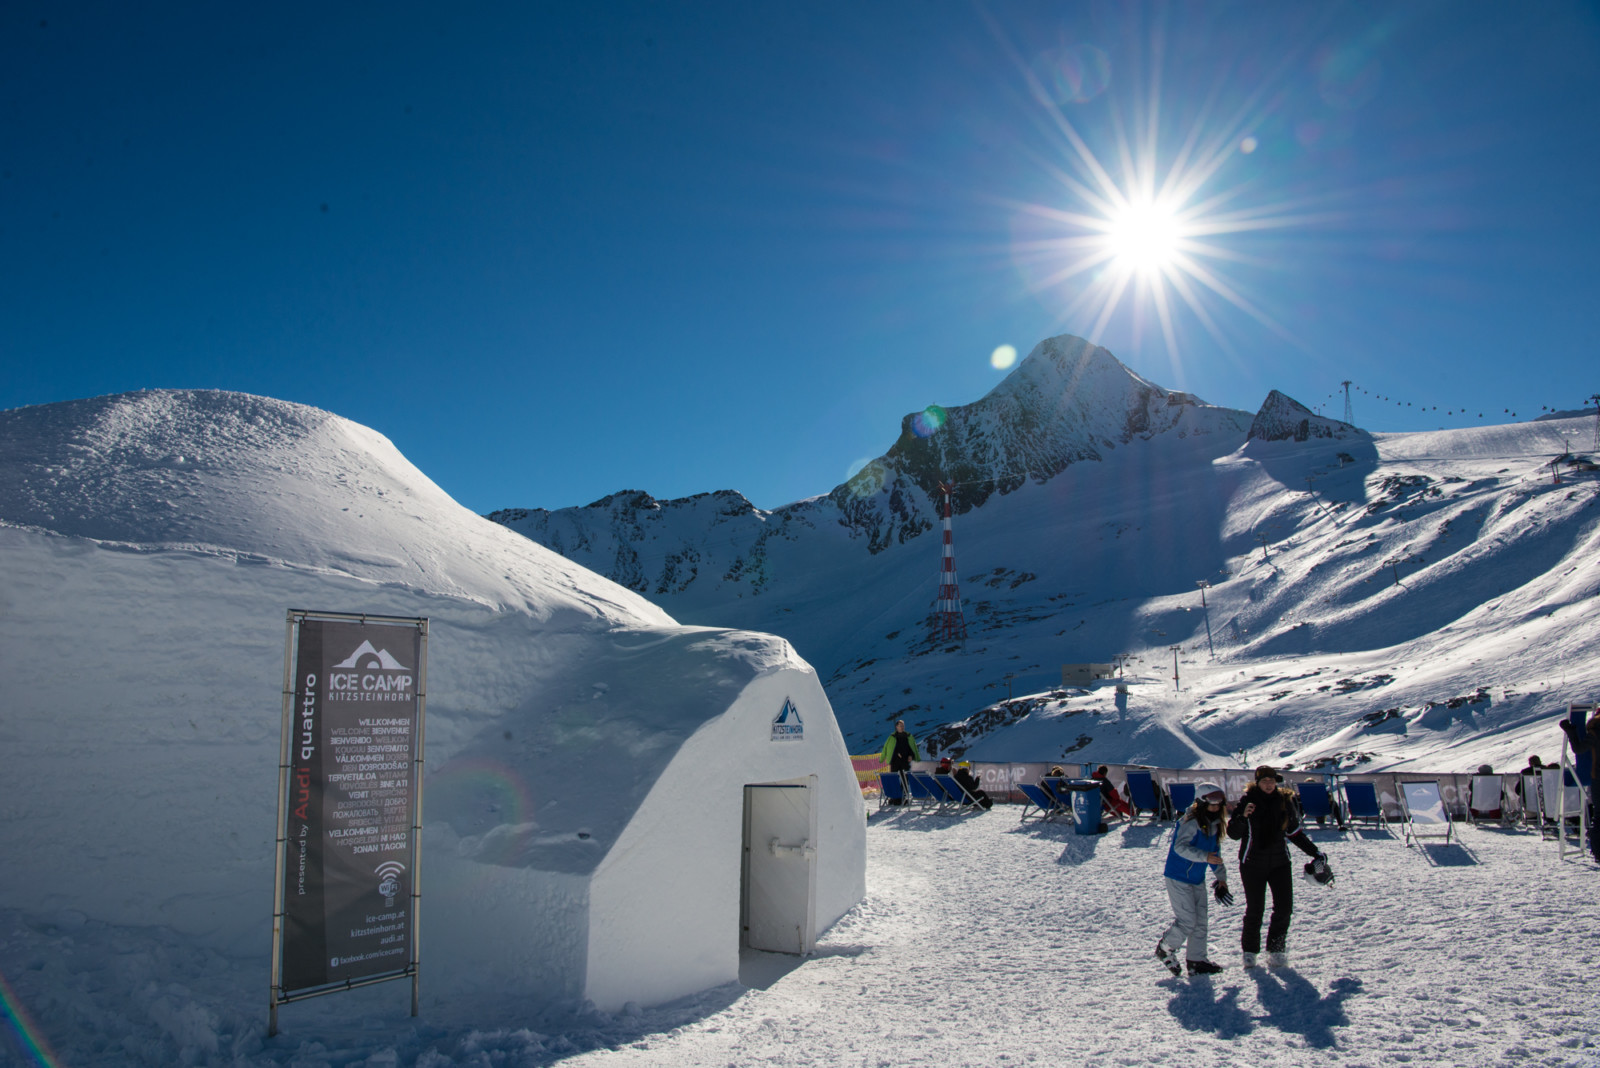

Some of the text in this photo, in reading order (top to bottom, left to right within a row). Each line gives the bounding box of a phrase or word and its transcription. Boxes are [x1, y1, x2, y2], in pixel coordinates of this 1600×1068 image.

[329, 673, 412, 691] ICE CAMP
[328, 692, 411, 701] KITZSTEINHORN
[301, 673, 317, 760] quattro
[358, 718, 410, 726] WILLKOMMEN
[330, 727, 410, 735] WELCOME BIENVENUE
[330, 736, 372, 745] BIENVENIDO
[335, 753, 384, 763] VÄLKOMMEN
[328, 772, 377, 782] TERVETULOA
[986, 767, 1026, 783] CAMP
[295, 767, 310, 819] Audi
[348, 790, 369, 799] VENIT
[300, 824, 309, 837] by
[328, 826, 379, 838] VELKOMMEN
[380, 834, 388, 842] NI
[389, 832, 407, 841] HAO
[380, 842, 407, 851] TAGON
[365, 910, 405, 923] ice-camp.at
[350, 922, 404, 938] kitzsteinhorn.at
[380, 933, 404, 945] audi.at
